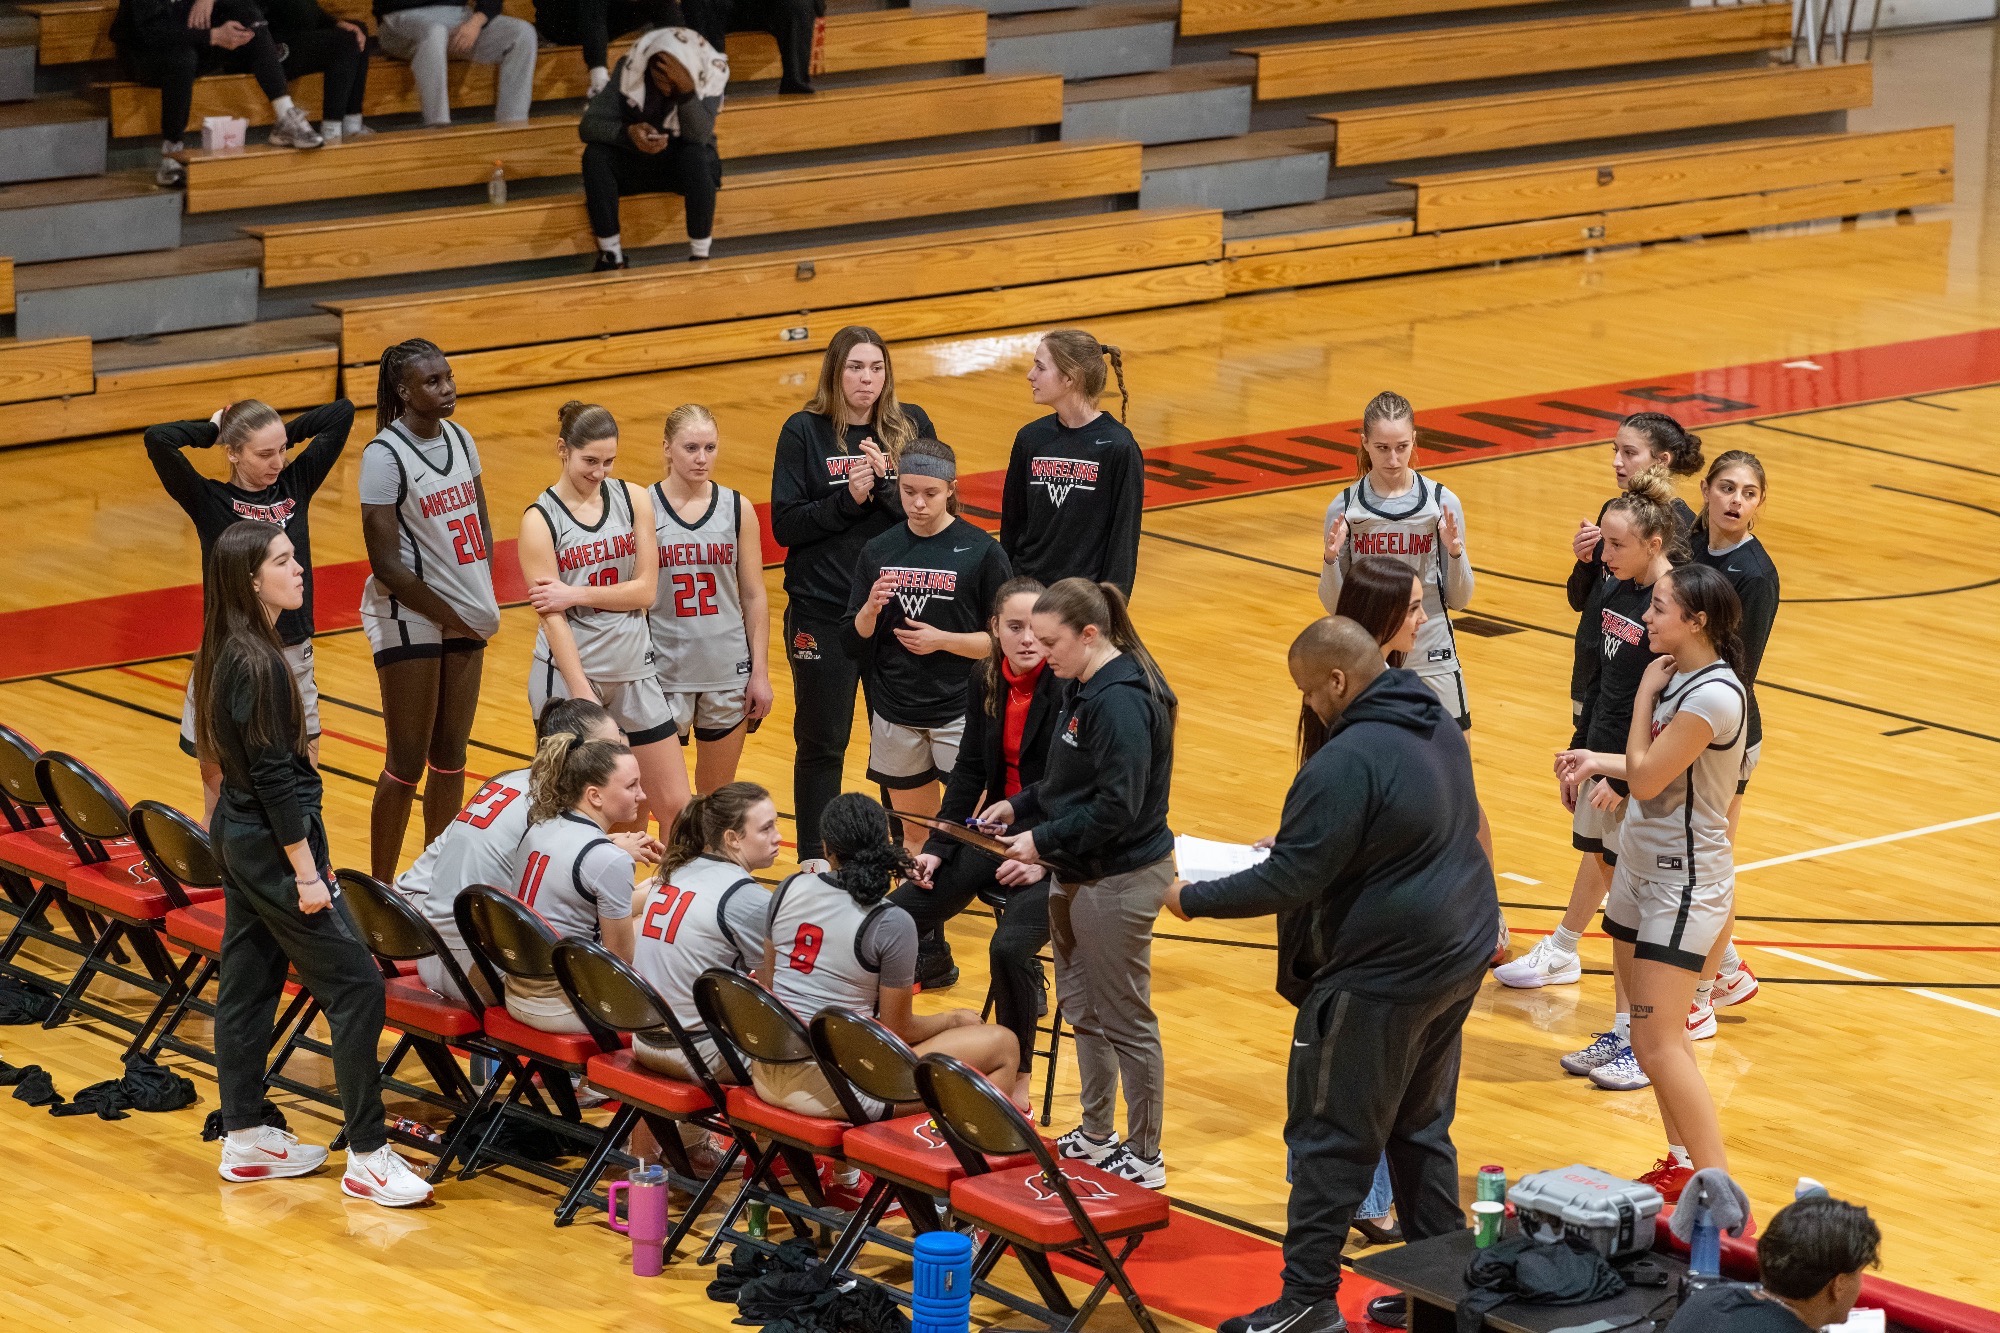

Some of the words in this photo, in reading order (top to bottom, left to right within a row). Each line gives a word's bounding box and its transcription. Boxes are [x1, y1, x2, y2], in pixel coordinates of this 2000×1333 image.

[1031, 459, 1099, 482] WHEELING
[446, 513, 487, 566] 20
[1353, 532, 1434, 556] WHEELING
[671, 572, 719, 618] 22
[456, 781, 521, 830] 23
[517, 850, 551, 908] 11
[642, 883, 697, 945] 21
[789, 922, 824, 975] 8
